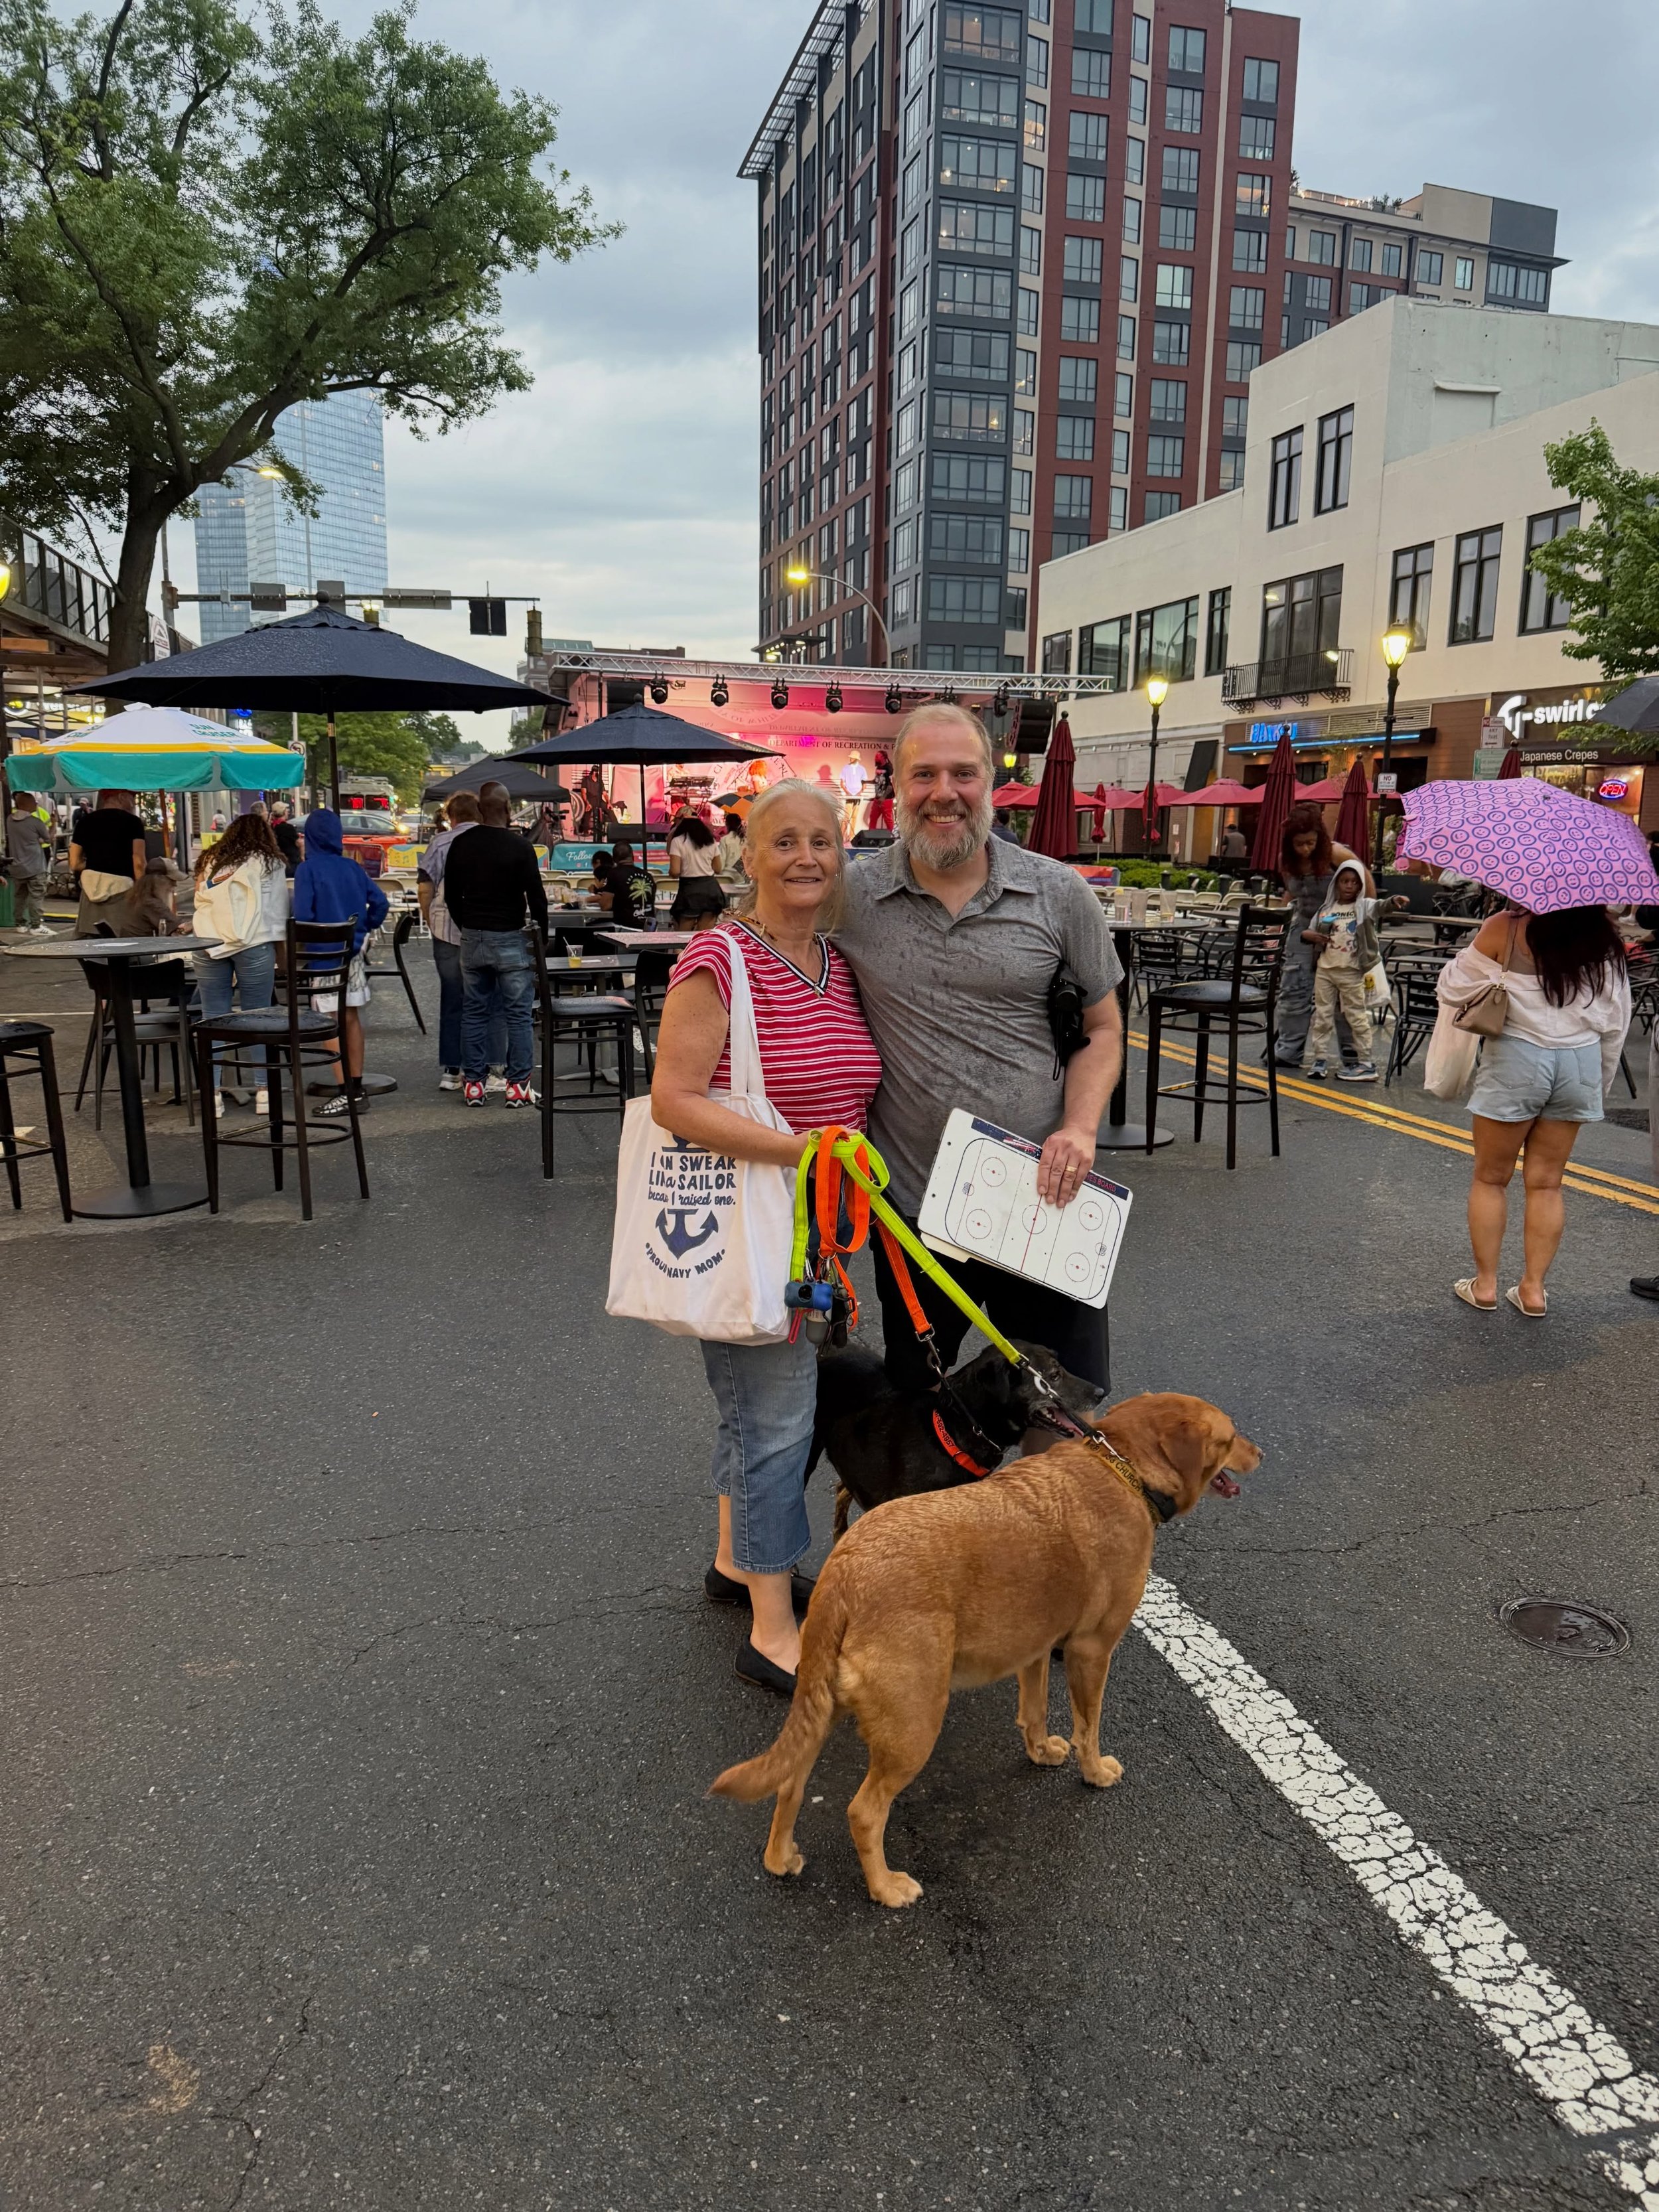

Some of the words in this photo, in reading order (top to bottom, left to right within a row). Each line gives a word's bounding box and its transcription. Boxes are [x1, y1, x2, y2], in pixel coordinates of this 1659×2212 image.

[834, 741, 881, 750] RECREATION
[1520, 751, 1563, 763] Japanese
[1564, 749, 1599, 762] Crepes
[1599, 784, 1626, 796] OPEN
[651, 1151, 656, 1168] I
[666, 1176, 676, 1188] a
[678, 1173, 737, 1191] SAILOR
[1096, 1178, 1117, 1193] BOARD
[678, 1192, 712, 1207] raised
[667, 1267, 691, 1279] NAVY
[694, 1252, 723, 1275] MOM
